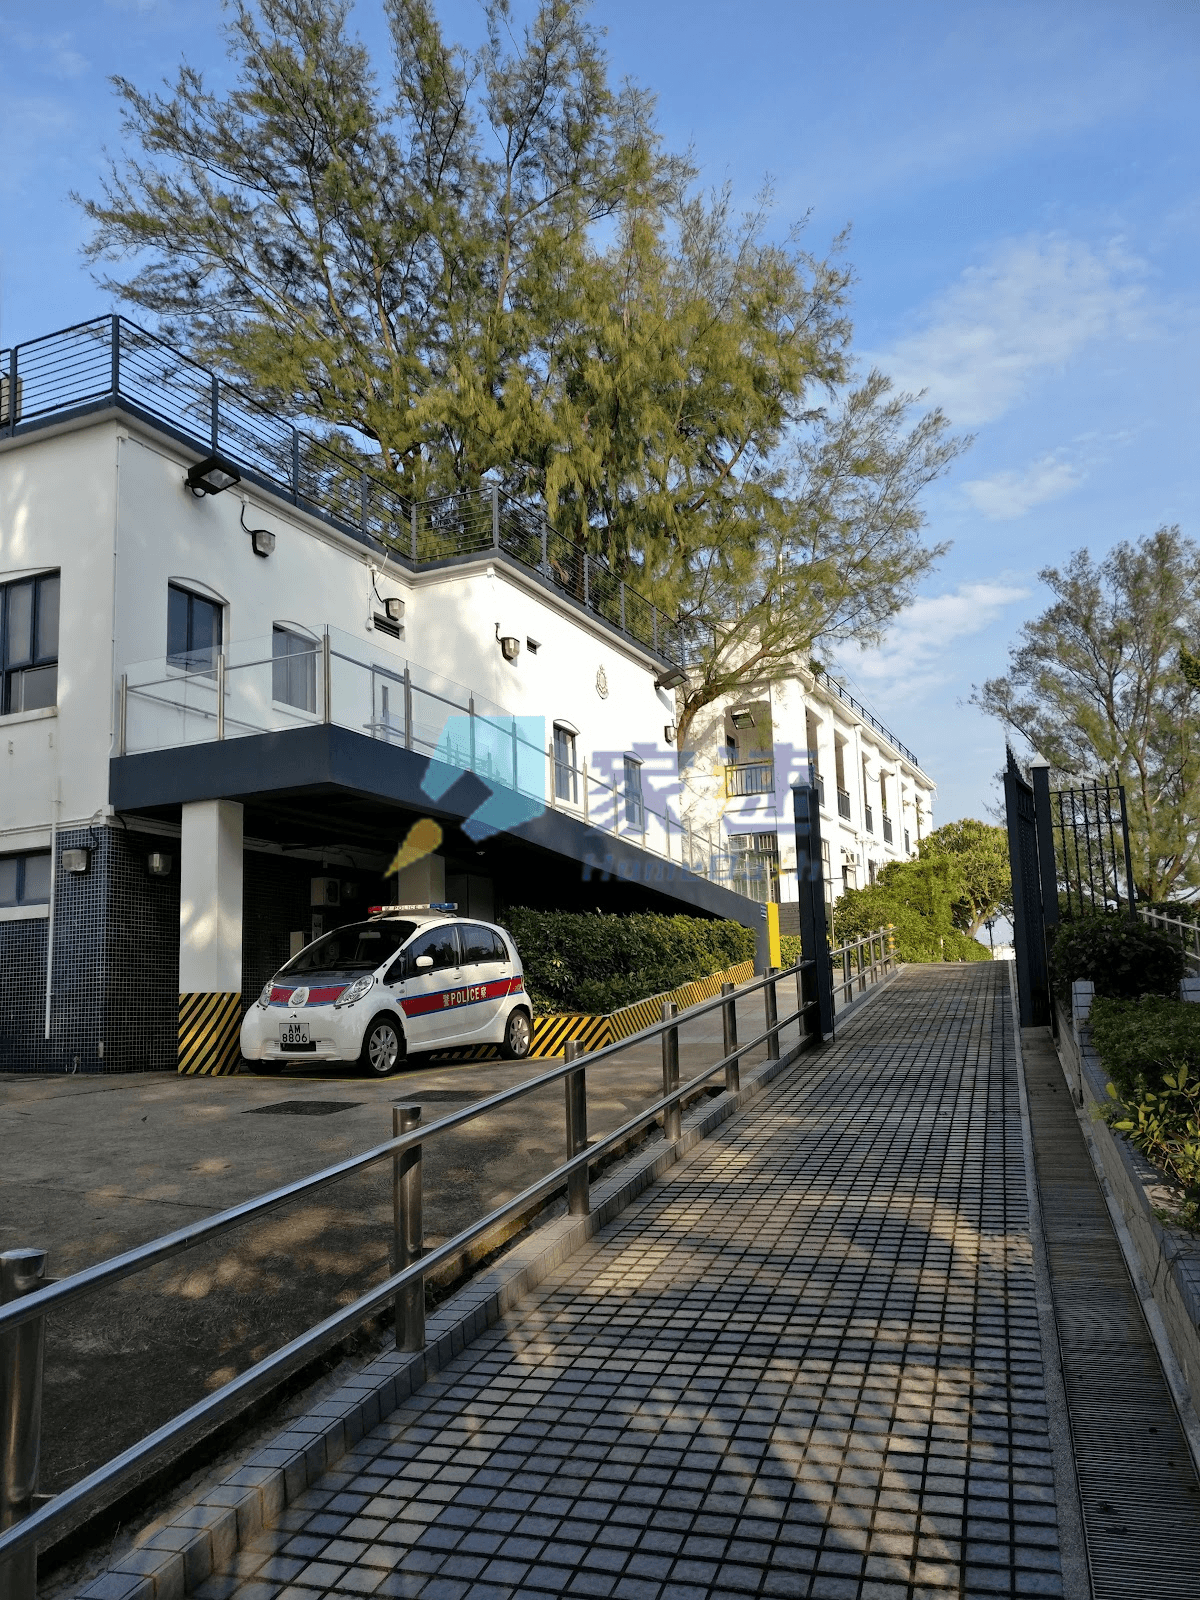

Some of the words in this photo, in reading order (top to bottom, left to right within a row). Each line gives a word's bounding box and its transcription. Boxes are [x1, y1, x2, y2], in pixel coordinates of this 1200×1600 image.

[450, 987, 480, 1006] POLICE
[288, 1024, 301, 1034] AM
[282, 1033, 308, 1043] 8806
